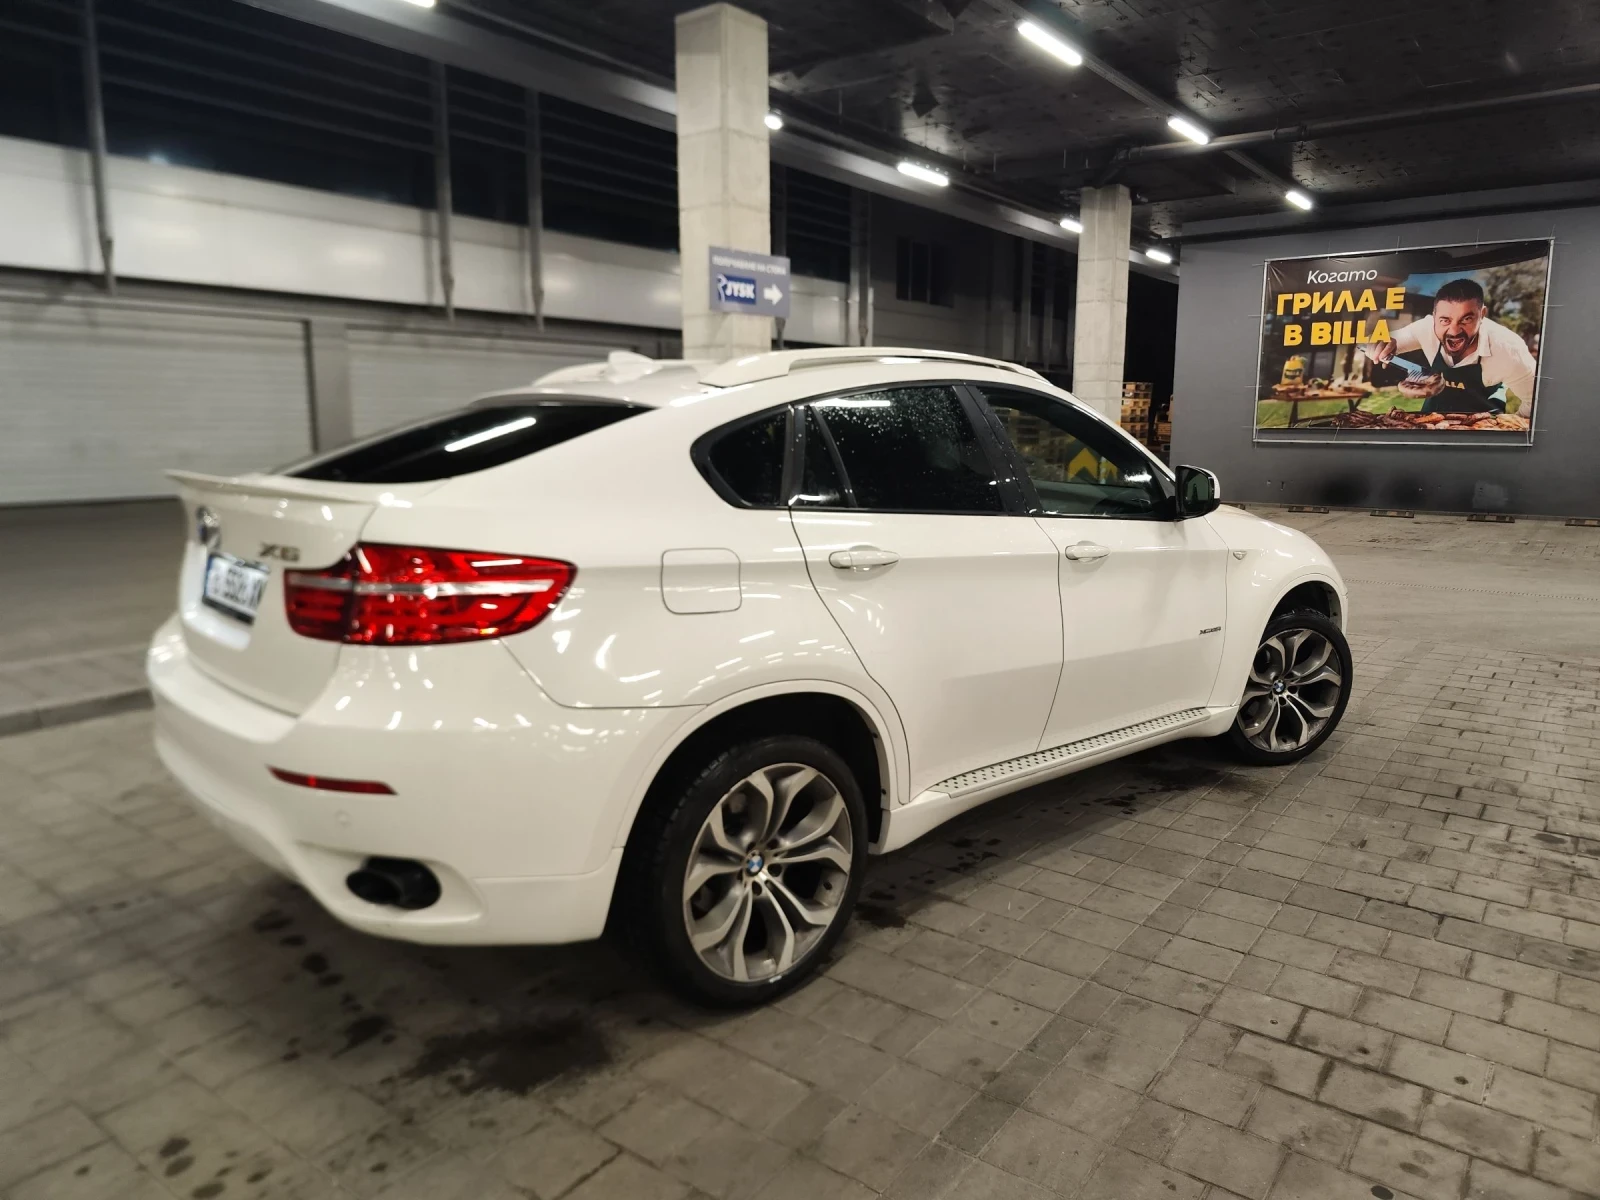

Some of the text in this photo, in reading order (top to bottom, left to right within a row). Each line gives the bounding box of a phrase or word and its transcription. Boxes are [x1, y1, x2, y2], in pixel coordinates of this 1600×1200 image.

[1307, 268, 1378, 285] Когато
[725, 280, 755, 299] JYSK
[1276, 287, 1406, 316] ГРИЛА Е
[1310, 319, 1391, 346] BILLA
[259, 543, 300, 562] X6
